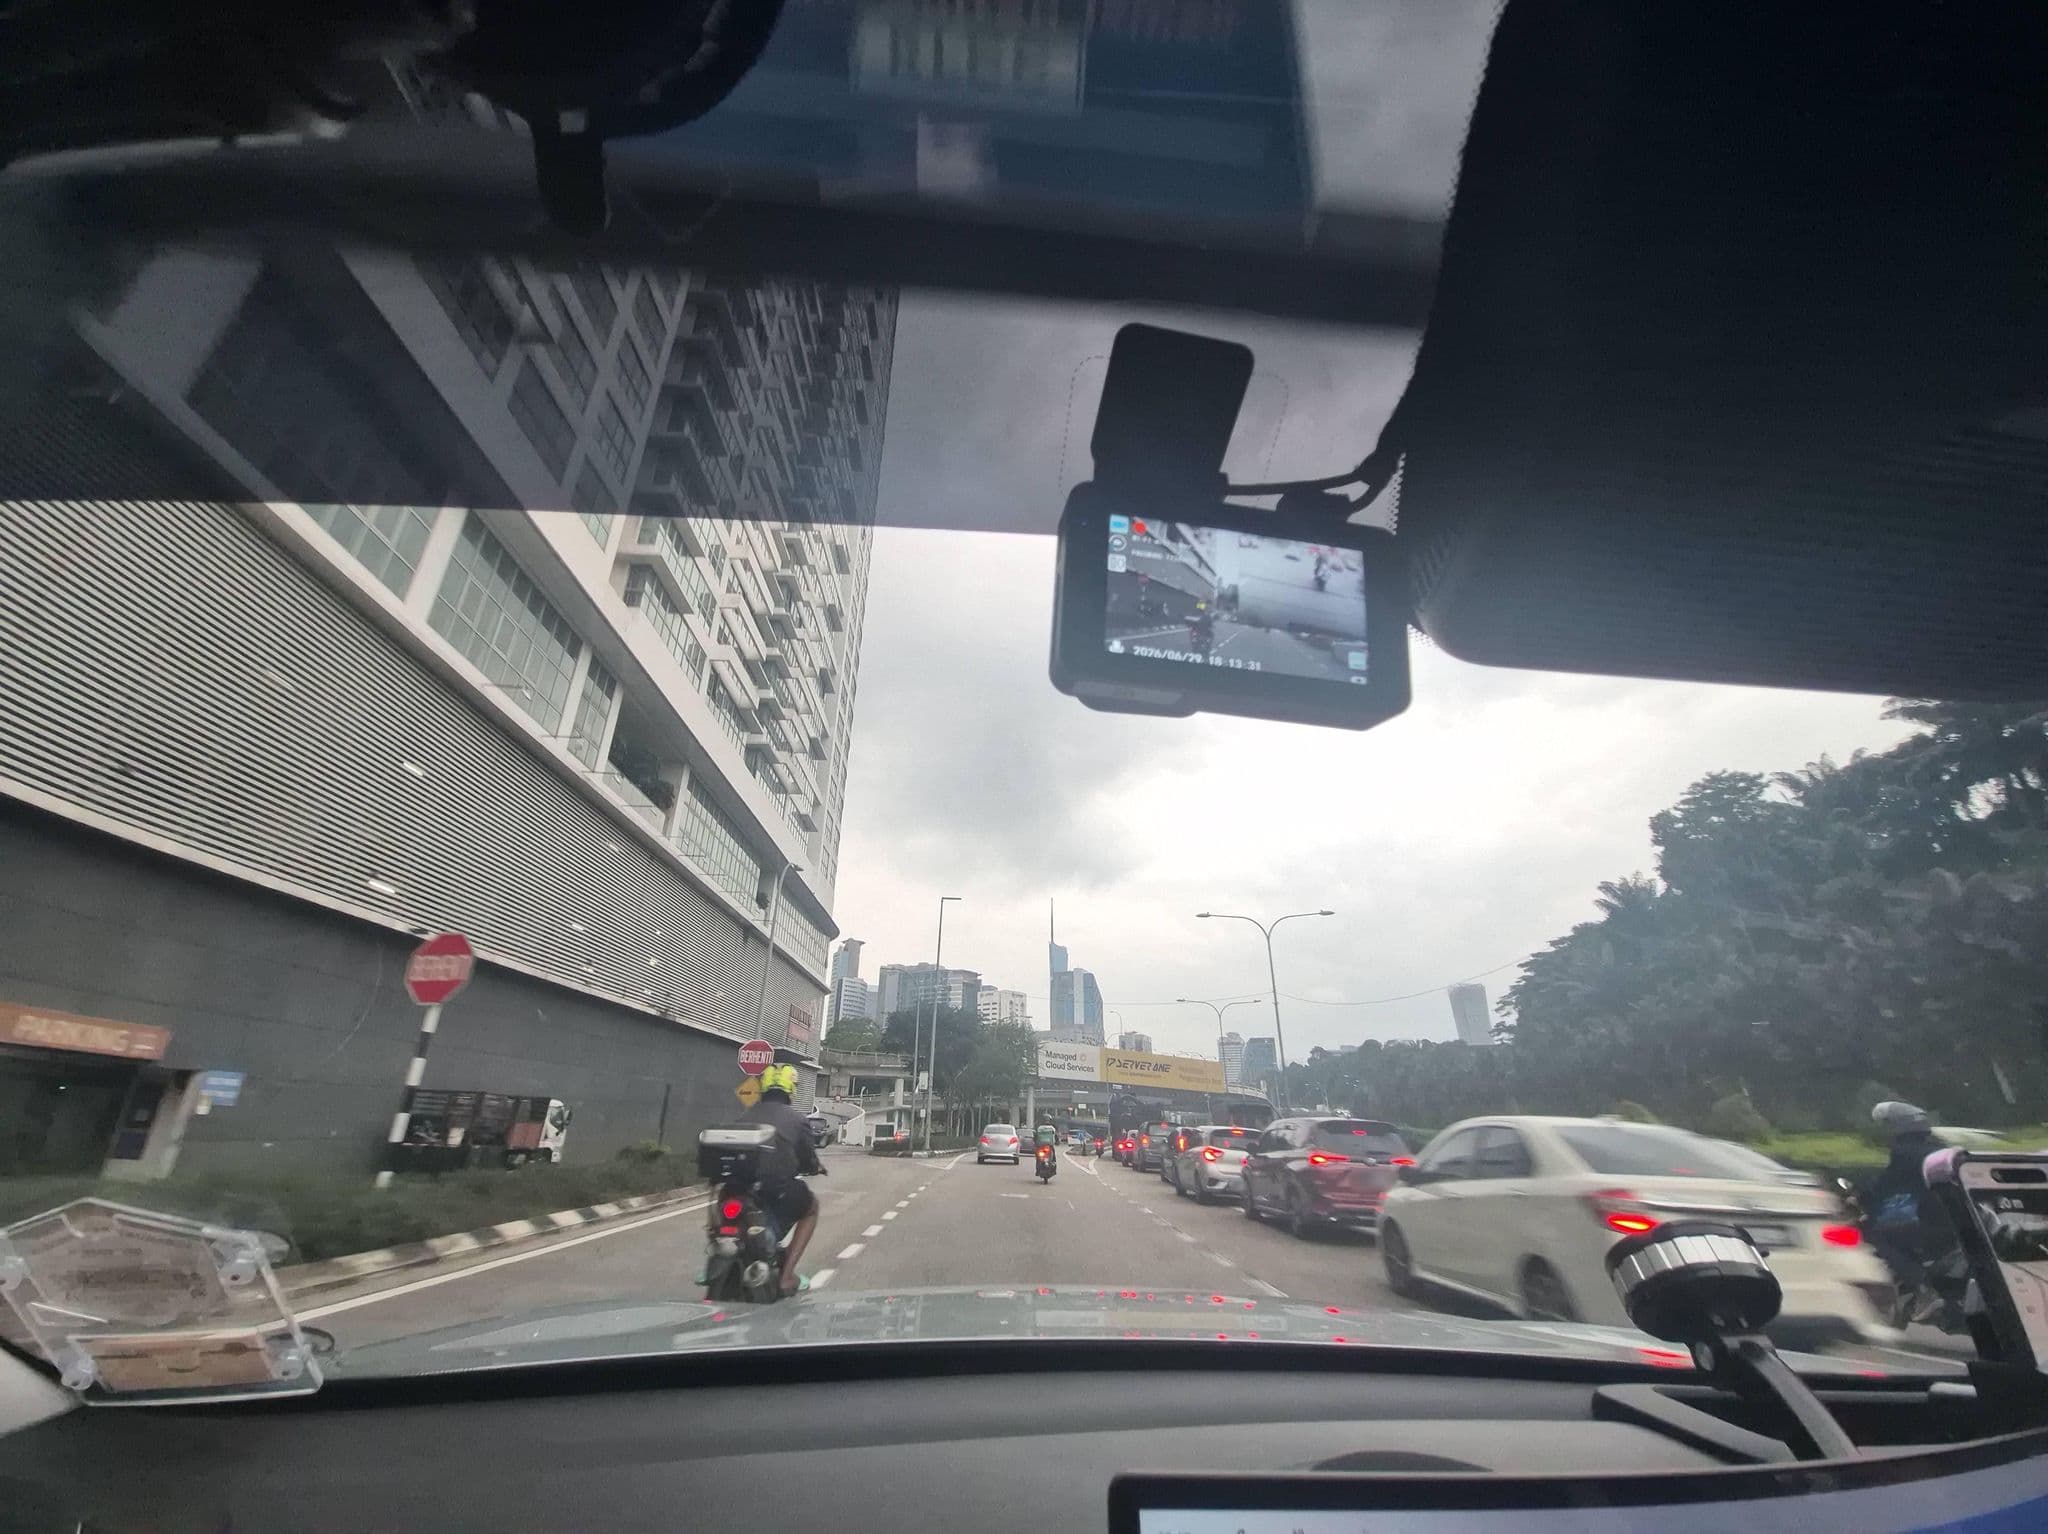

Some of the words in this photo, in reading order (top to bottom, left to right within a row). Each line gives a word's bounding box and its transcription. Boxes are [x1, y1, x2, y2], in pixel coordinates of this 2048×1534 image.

[740, 1049, 773, 1065] BERHENTI
[1045, 1050, 1077, 1062] Managed
[1045, 1060, 1066, 1071] Cloud
[1066, 1062, 1095, 1073] Services
